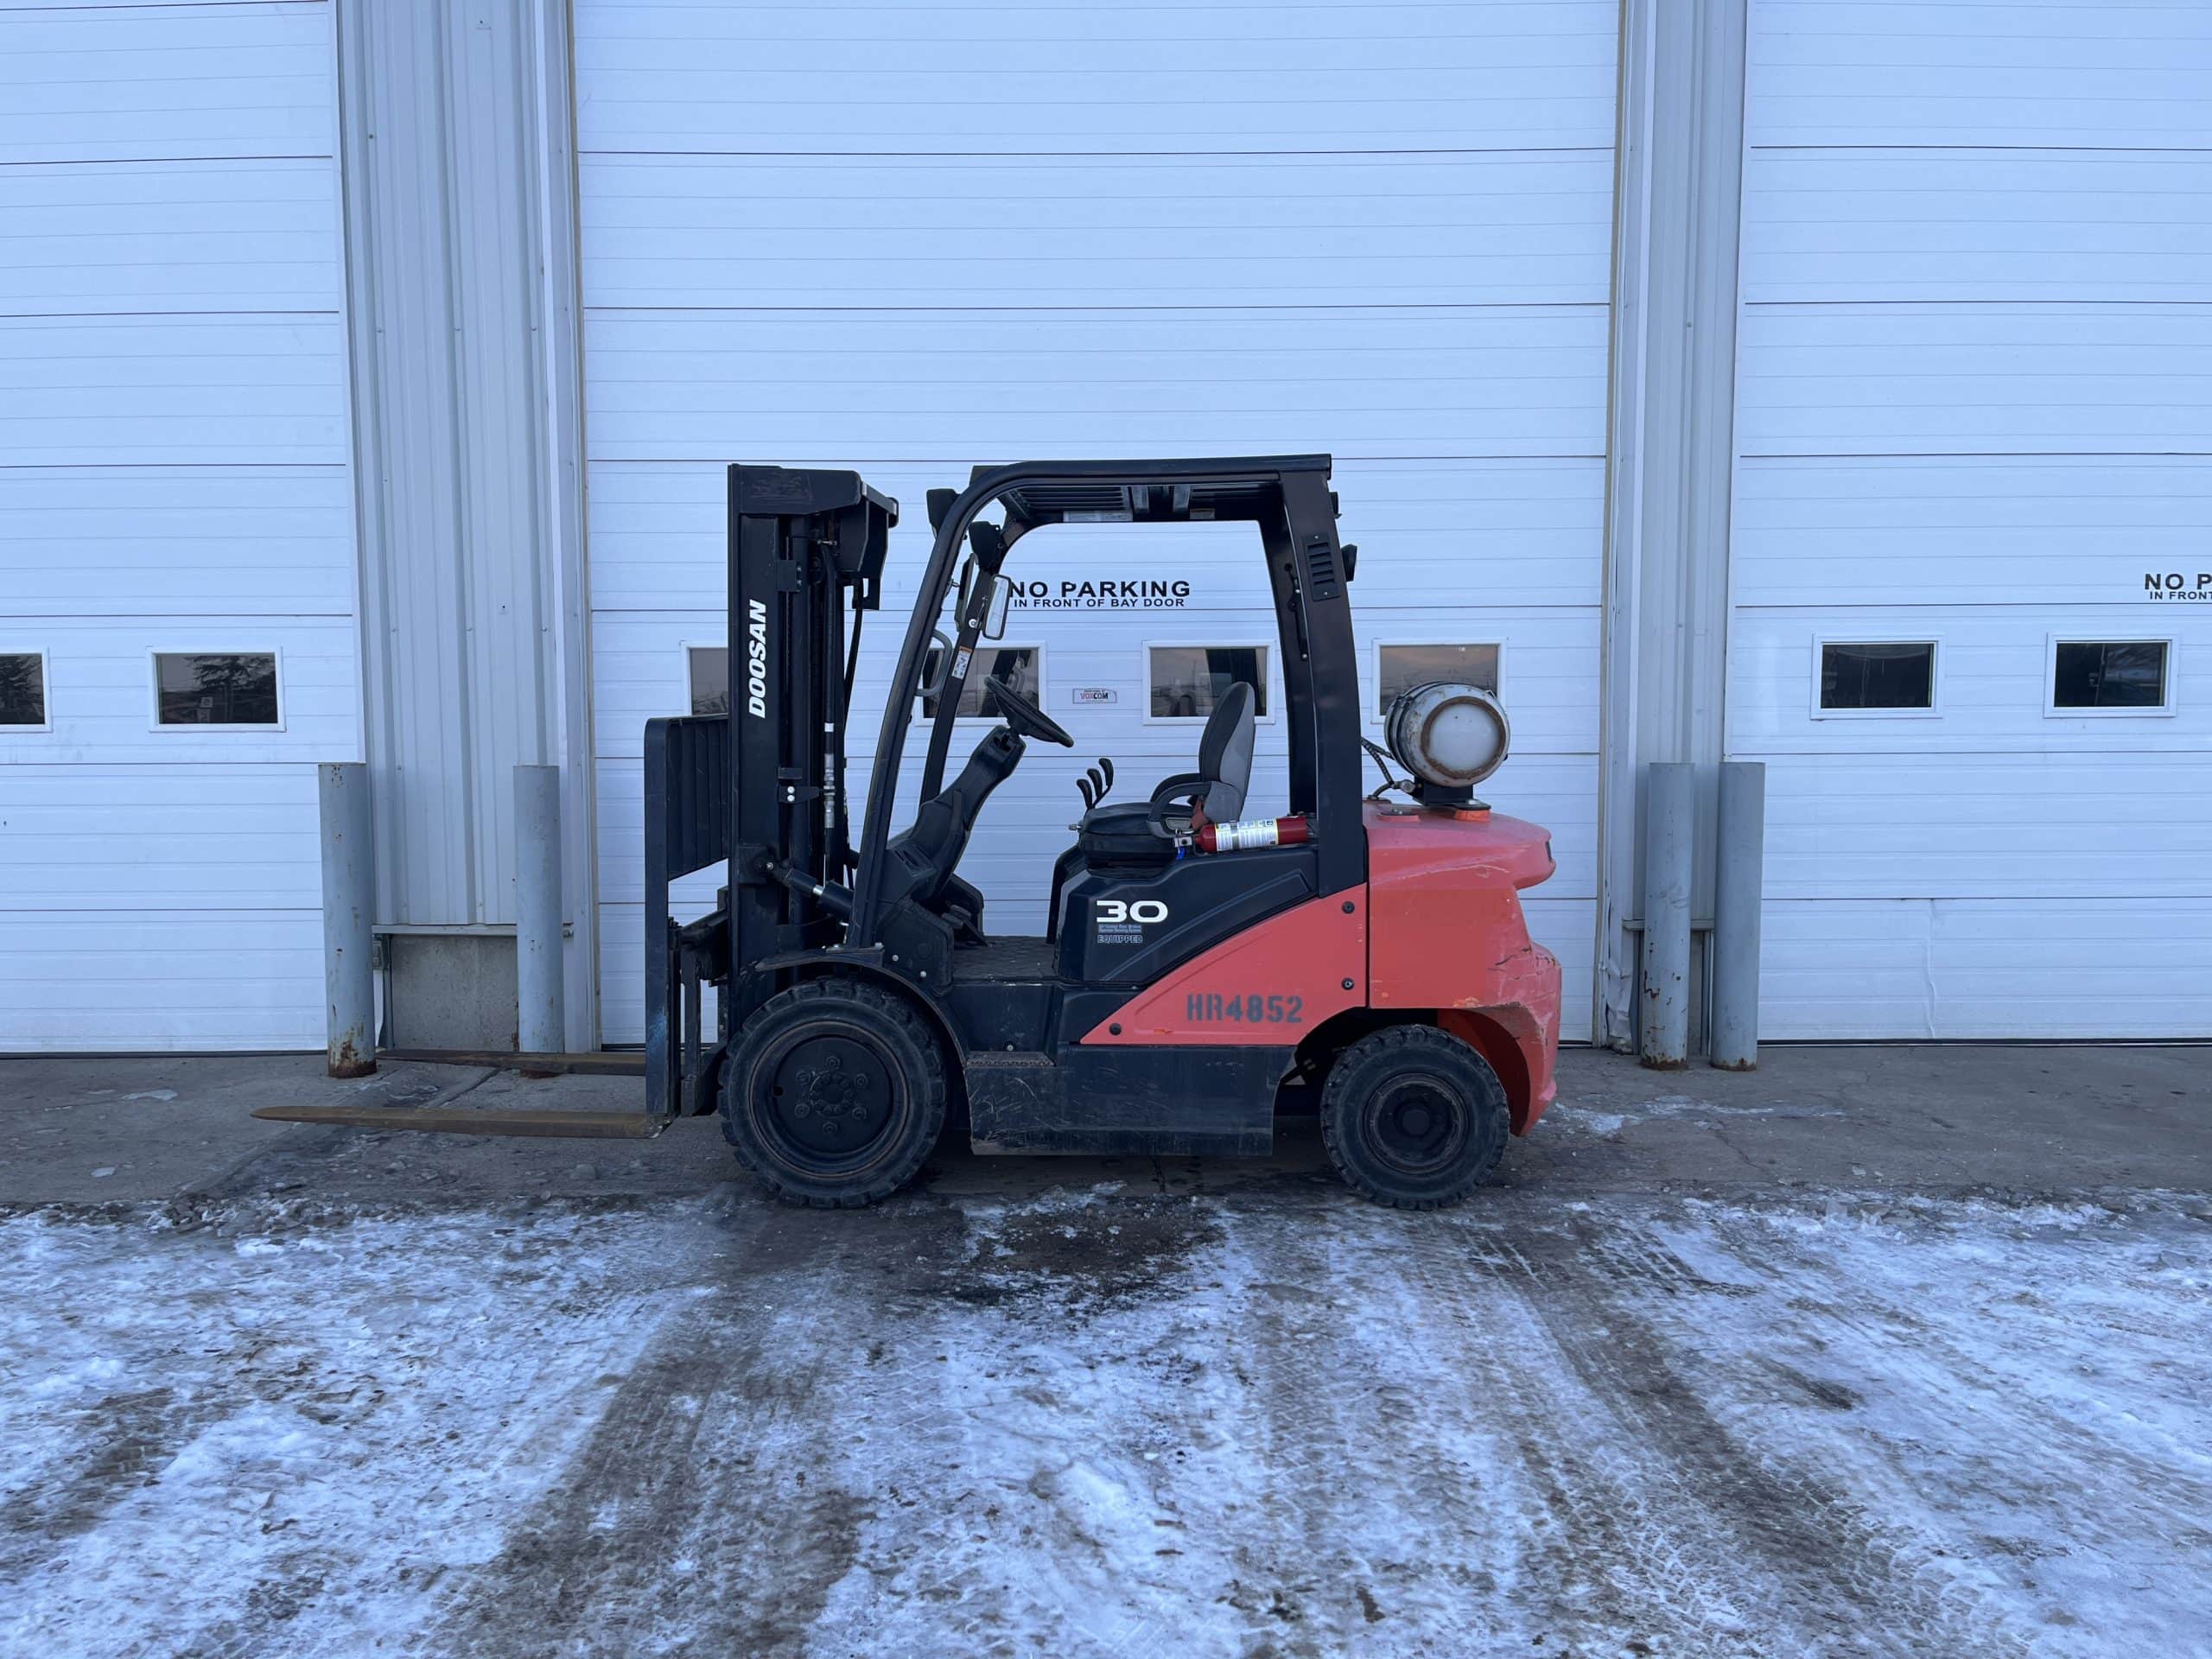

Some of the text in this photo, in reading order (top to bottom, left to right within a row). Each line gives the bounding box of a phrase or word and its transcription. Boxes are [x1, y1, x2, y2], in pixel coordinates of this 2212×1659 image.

[1009, 581, 1190, 598] NO PARKING
[2145, 573, 2184, 590] NO
[1014, 598, 1185, 607] IN FRONT OF BAY DOOR
[2149, 591, 2163, 600] IN
[748, 599, 767, 719] DOOSAN
[1096, 899, 1168, 923] 30
[1186, 994, 1304, 1023] HR4852
